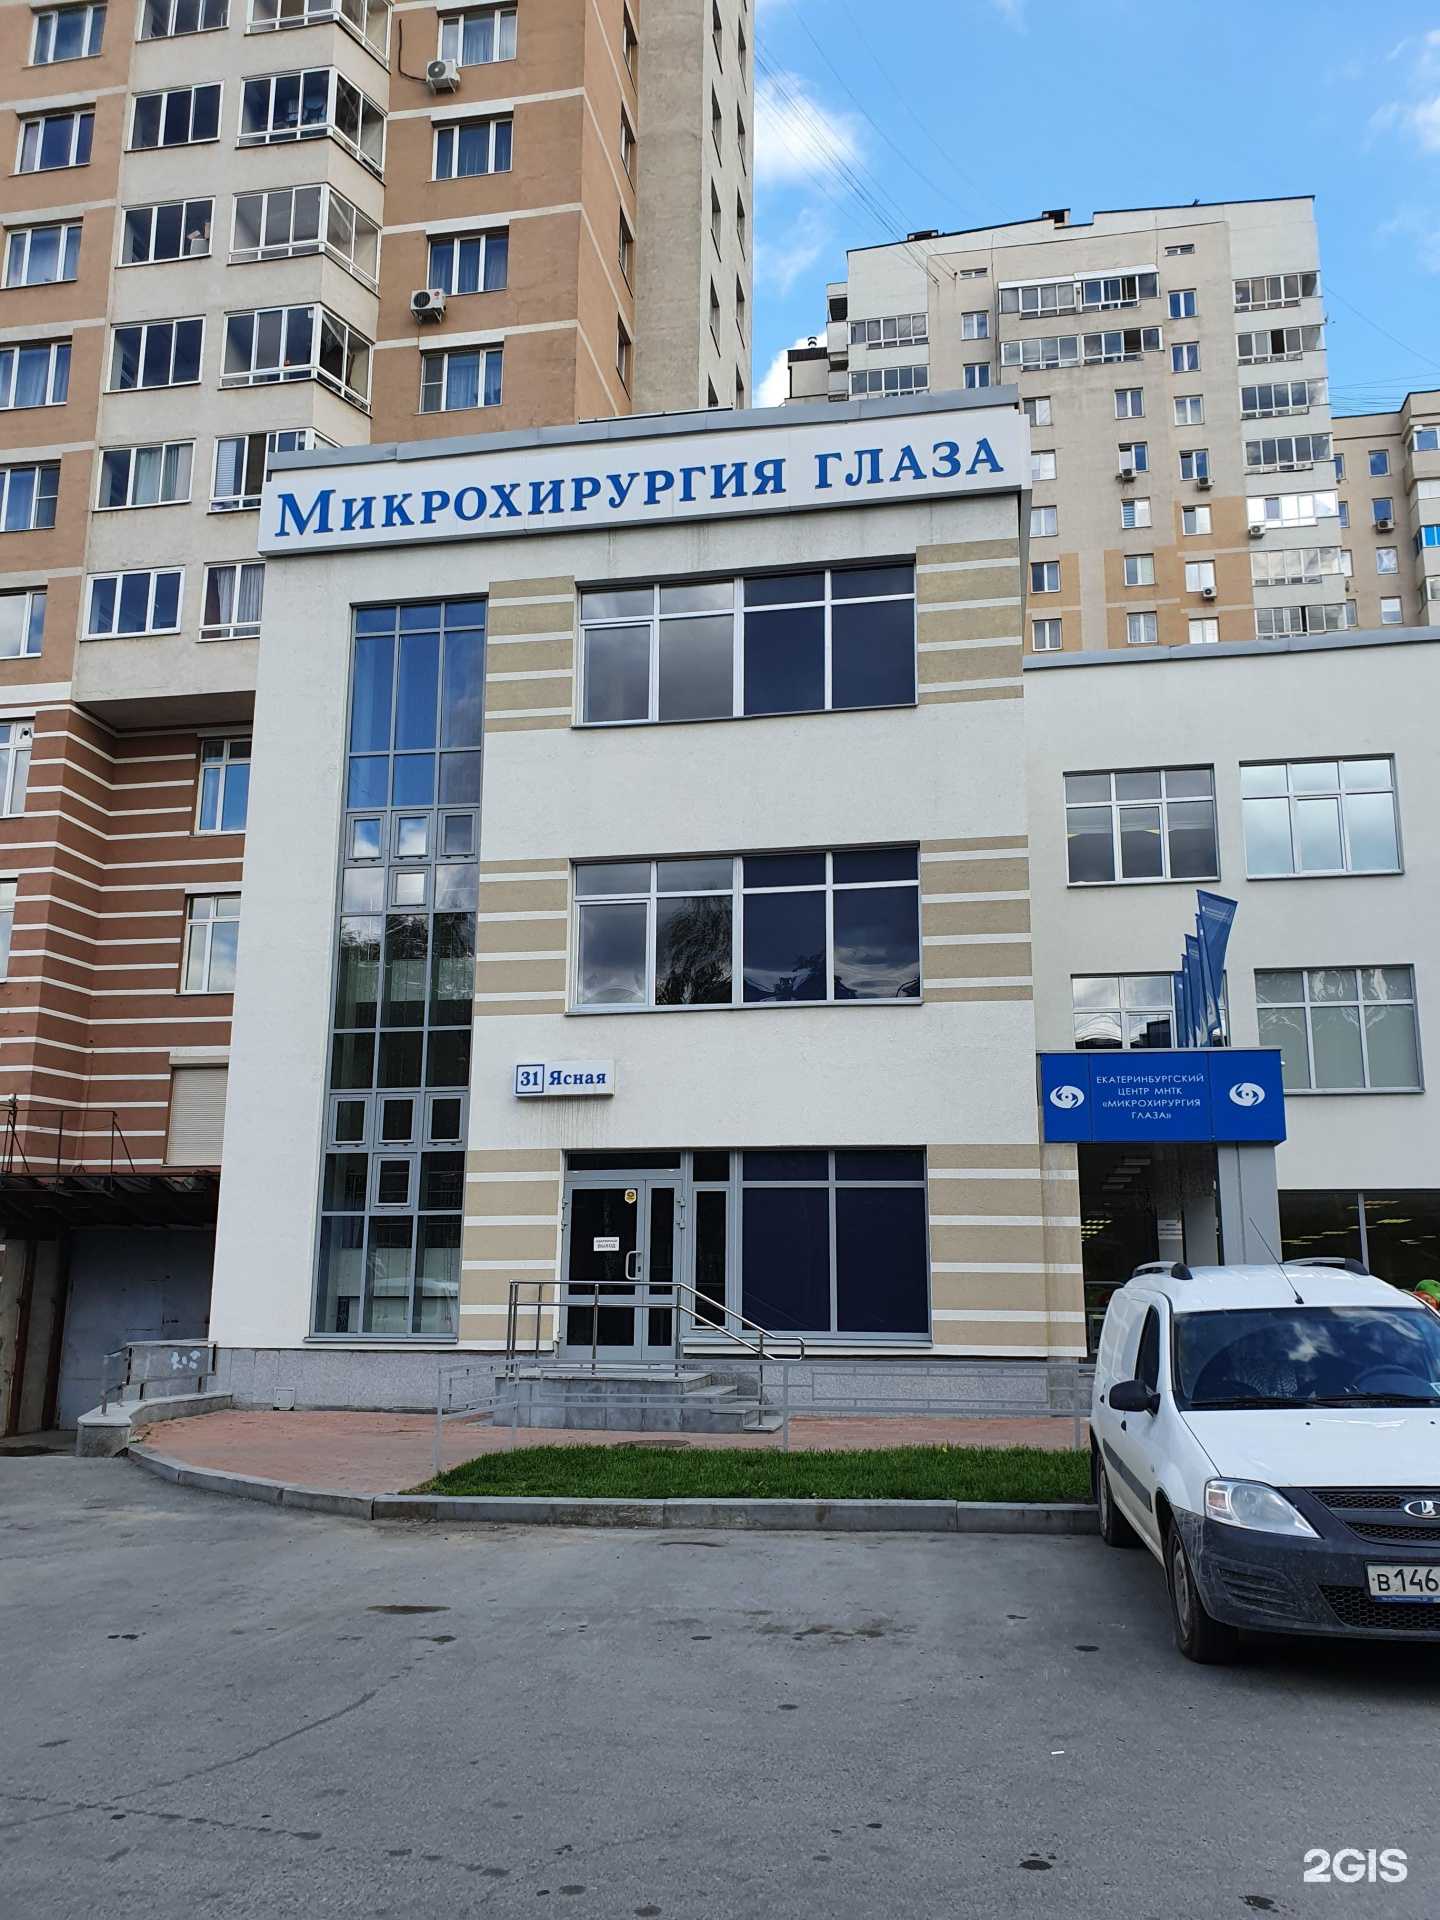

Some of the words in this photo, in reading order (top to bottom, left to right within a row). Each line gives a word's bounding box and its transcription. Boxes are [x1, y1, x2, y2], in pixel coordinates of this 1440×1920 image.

[520, 1071, 540, 1086] 31
[548, 1070, 607, 1086] Ясная
[1096, 1073, 1204, 1084] ЕКАТЕРИНБУРГСКИЙ
[1118, 1087, 1150, 1097] ЦЕНТР
[1154, 1087, 1183, 1096] МНТК
[1102, 1099, 1201, 1109] «МИКРОХИРУРГИЯ
[1131, 1111, 1172, 1120] ГЛАЗА»
